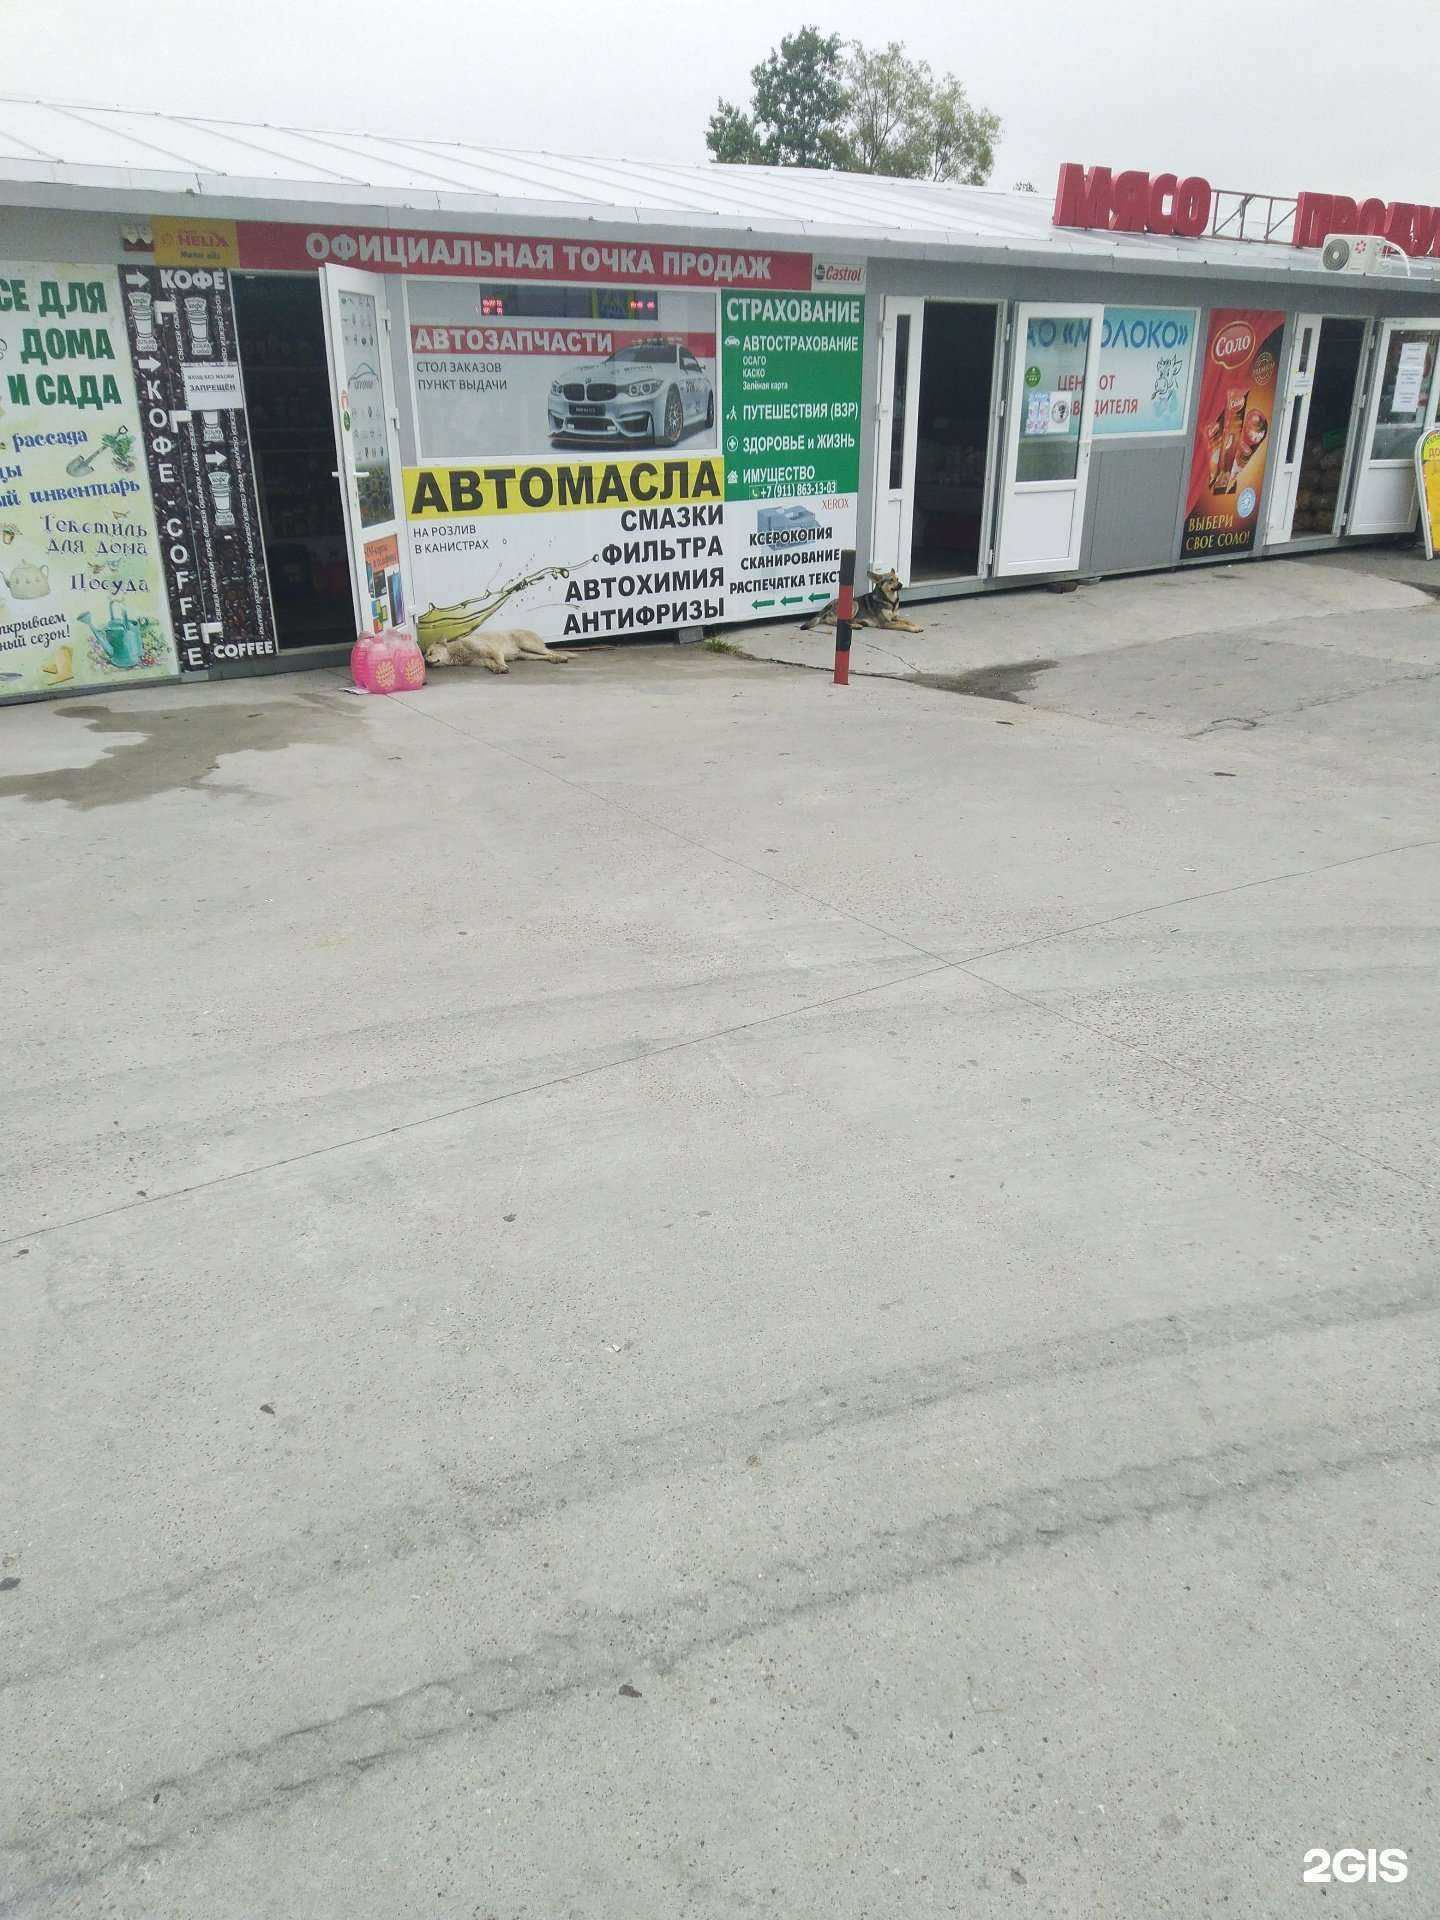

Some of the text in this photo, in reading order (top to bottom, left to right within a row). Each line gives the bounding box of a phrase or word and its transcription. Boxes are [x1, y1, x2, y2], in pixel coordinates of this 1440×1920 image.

[1053, 163, 1211, 236] МЯСО
[306, 232, 773, 281] ОФИЦИАЛЬНАЯ ТОЧКА ПРОДАЖ
[160, 269, 226, 289] КОФЕ
[826, 265, 862, 281] Castrol
[38, 281, 108, 319] ДЛЯ
[726, 298, 860, 323] СТРАХОВАНИЕ
[20, 328, 115, 365] ДОМА
[415, 328, 612, 353] АВТОЗАПЧАСТИ
[743, 335, 858, 351] АВТОСТРАХОВАНИЕ
[1215, 335, 1251, 357] Соло
[416, 361, 502, 373] СТОЛ ЗАКАЗОВ
[742, 356, 767, 365] ОСАГО
[742, 368, 765, 378] КАСКО
[1057, 375, 1085, 391] ЦЕН
[1099, 374, 1115, 391] ОТ
[7, 373, 122, 410] И САДА
[189, 383, 236, 391] ЗАПРЕЩЁН
[418, 379, 507, 392] ПУНКТ ВЫДАЧИ
[770, 381, 788, 391] карта
[743, 402, 859, 421] ПУТЕШЕСТВИЯ (ВЗР)
[12, 430, 88, 453] рассада
[743, 433, 855, 454] ЗДОРОВЬЕ и ЖИЗНЬ
[743, 465, 815, 484] ИМУЩЕСТВО
[30, 479, 140, 504] инвентарь
[411, 460, 721, 514] АВТОМАСЛА
[760, 481, 836, 498] +7 (911) 863-13-03
[822, 498, 849, 511] XEROX
[41, 512, 148, 537] Текстиль
[621, 504, 724, 532] СМАЗКИ
[1187, 513, 1234, 532] ВЫБЕРИ
[413, 524, 476, 538] НА РОЗЛИВ
[749, 526, 833, 546] КСЕРОКОПИЯ
[1186, 530, 1250, 551] СВОЕ СОЛО!
[415, 539, 489, 554] В КАНИСТРАХ
[602, 535, 723, 566] ФИЛЬТРА
[740, 548, 840, 571] СКАНИРОВАНИЕ
[71, 573, 149, 596] Посуда
[565, 566, 724, 603] АВТОХИМИЯ
[729, 574, 805, 595] РАСПЕЧАТКА
[563, 598, 724, 635] АНТИФРИЗЫ
[30, 624, 71, 649] сезон!
[213, 640, 274, 658] COFFEE
